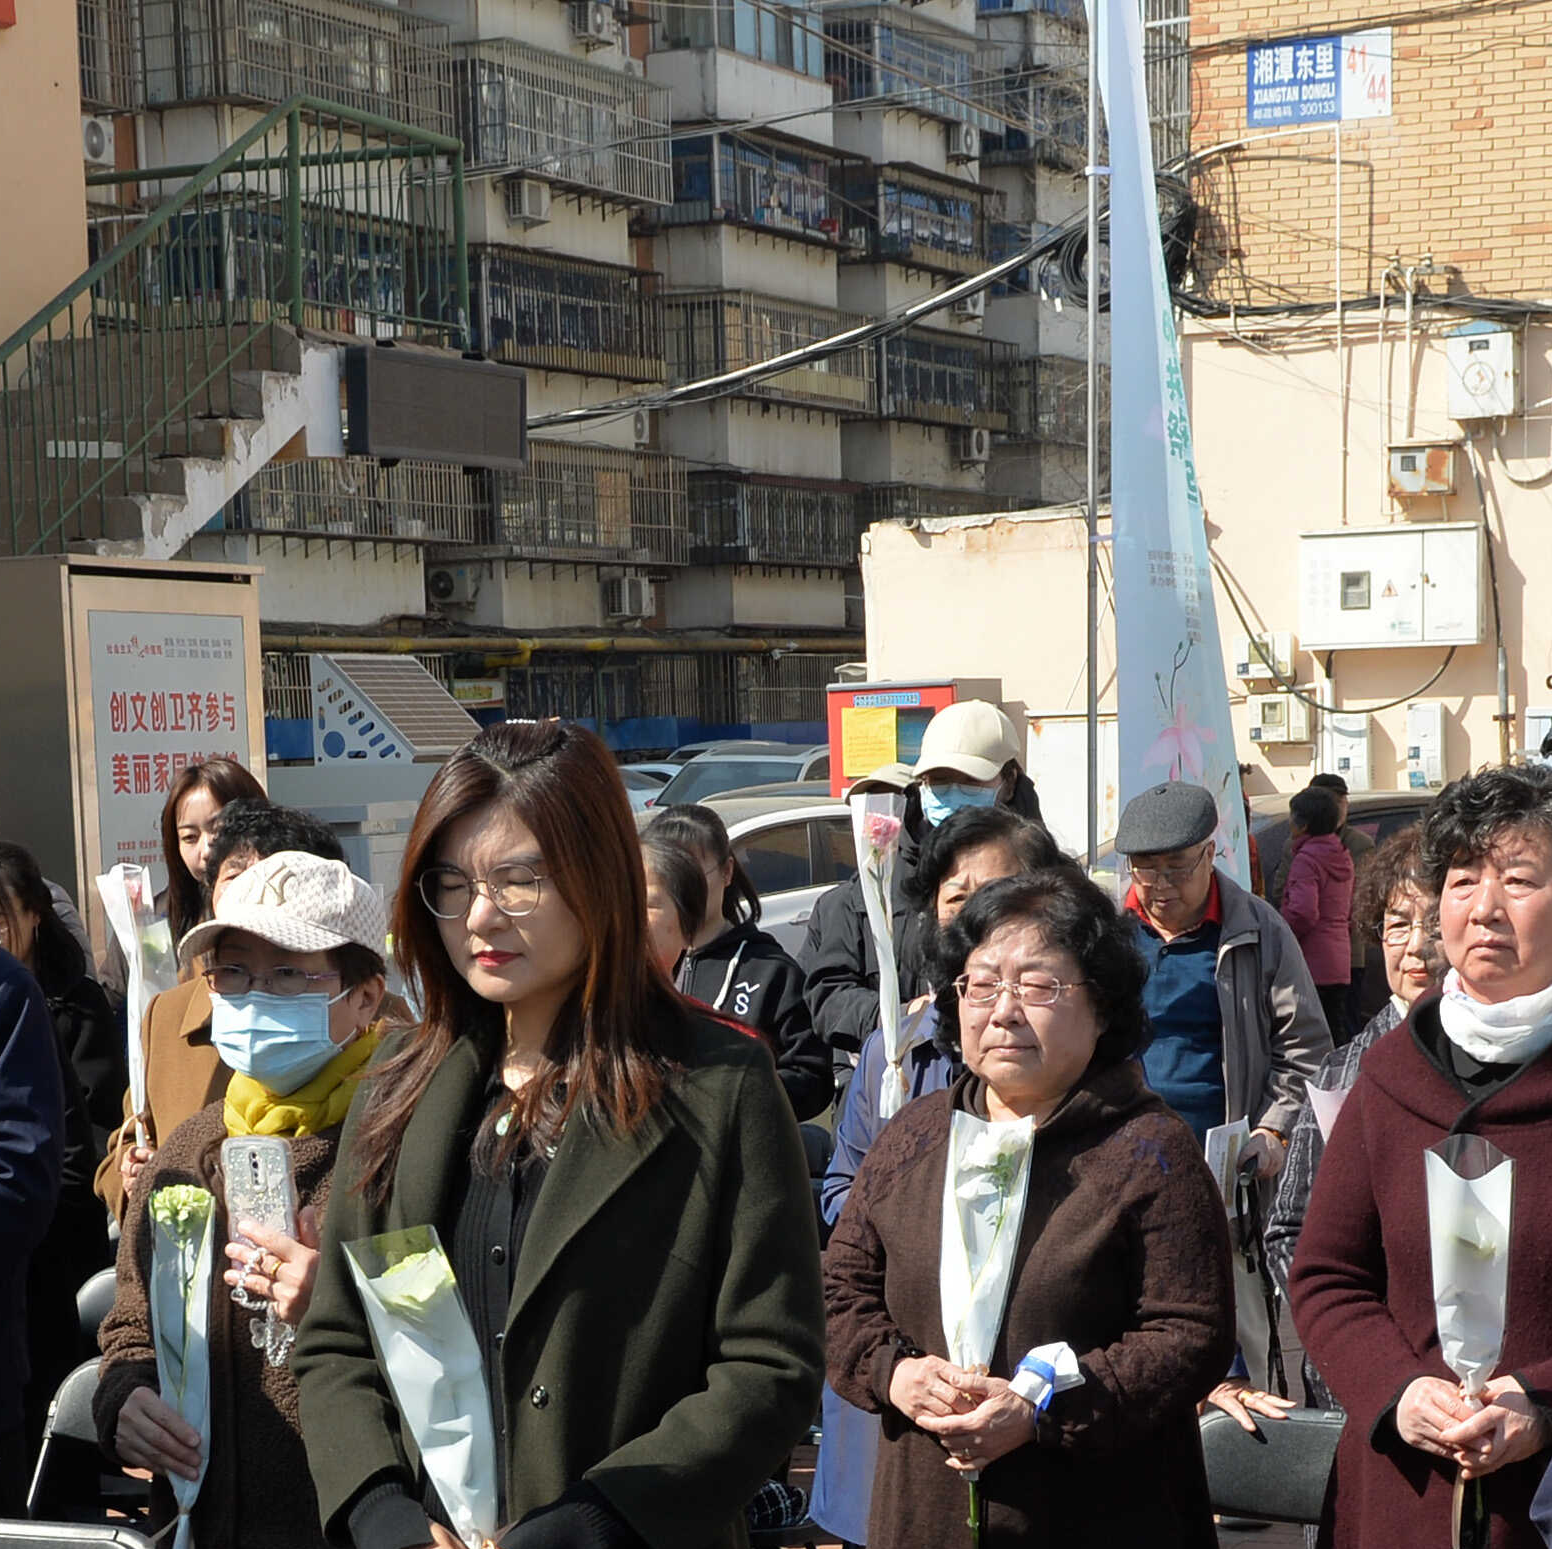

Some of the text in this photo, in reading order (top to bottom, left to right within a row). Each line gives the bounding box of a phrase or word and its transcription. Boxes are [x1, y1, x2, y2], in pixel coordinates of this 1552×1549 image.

[1253, 43, 1335, 85] 湘潭东里
[1253, 82, 1335, 105] XIANGTAN DONGLI
[1299, 100, 1335, 117] 300133
[110, 691, 236, 733] 创文创卫齐参与
